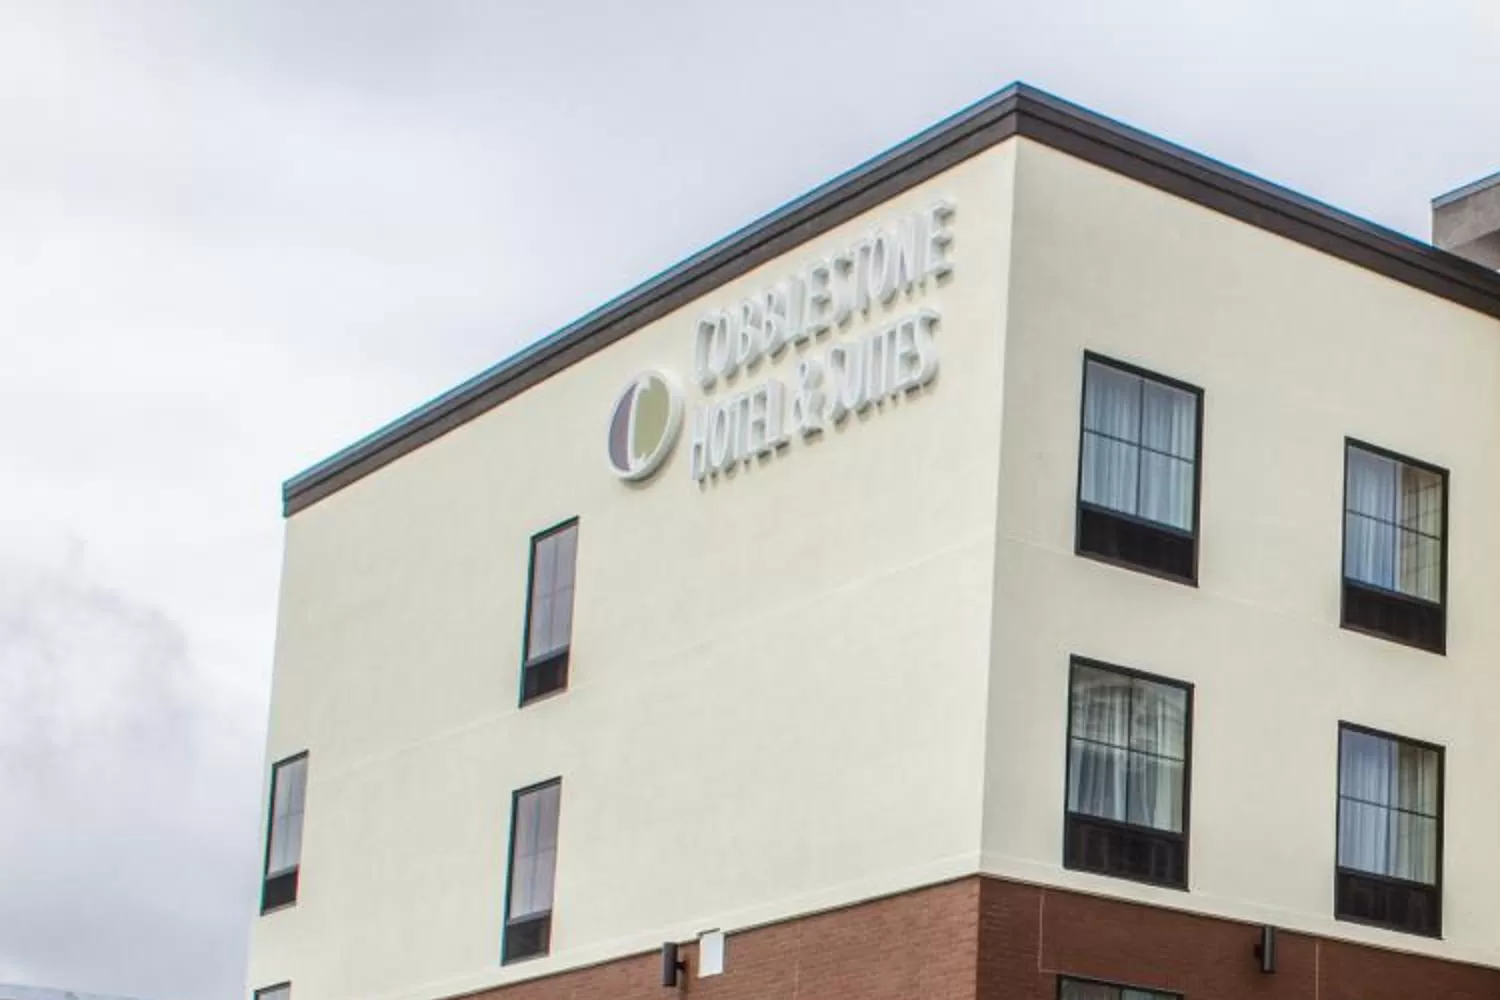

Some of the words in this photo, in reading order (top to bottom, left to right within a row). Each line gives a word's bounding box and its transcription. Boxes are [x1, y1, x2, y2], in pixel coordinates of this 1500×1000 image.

[694, 200, 955, 389] COBBLESTONE
[691, 378, 787, 483] HOTEL
[792, 359, 826, 436] &
[826, 308, 942, 425] SUITES
